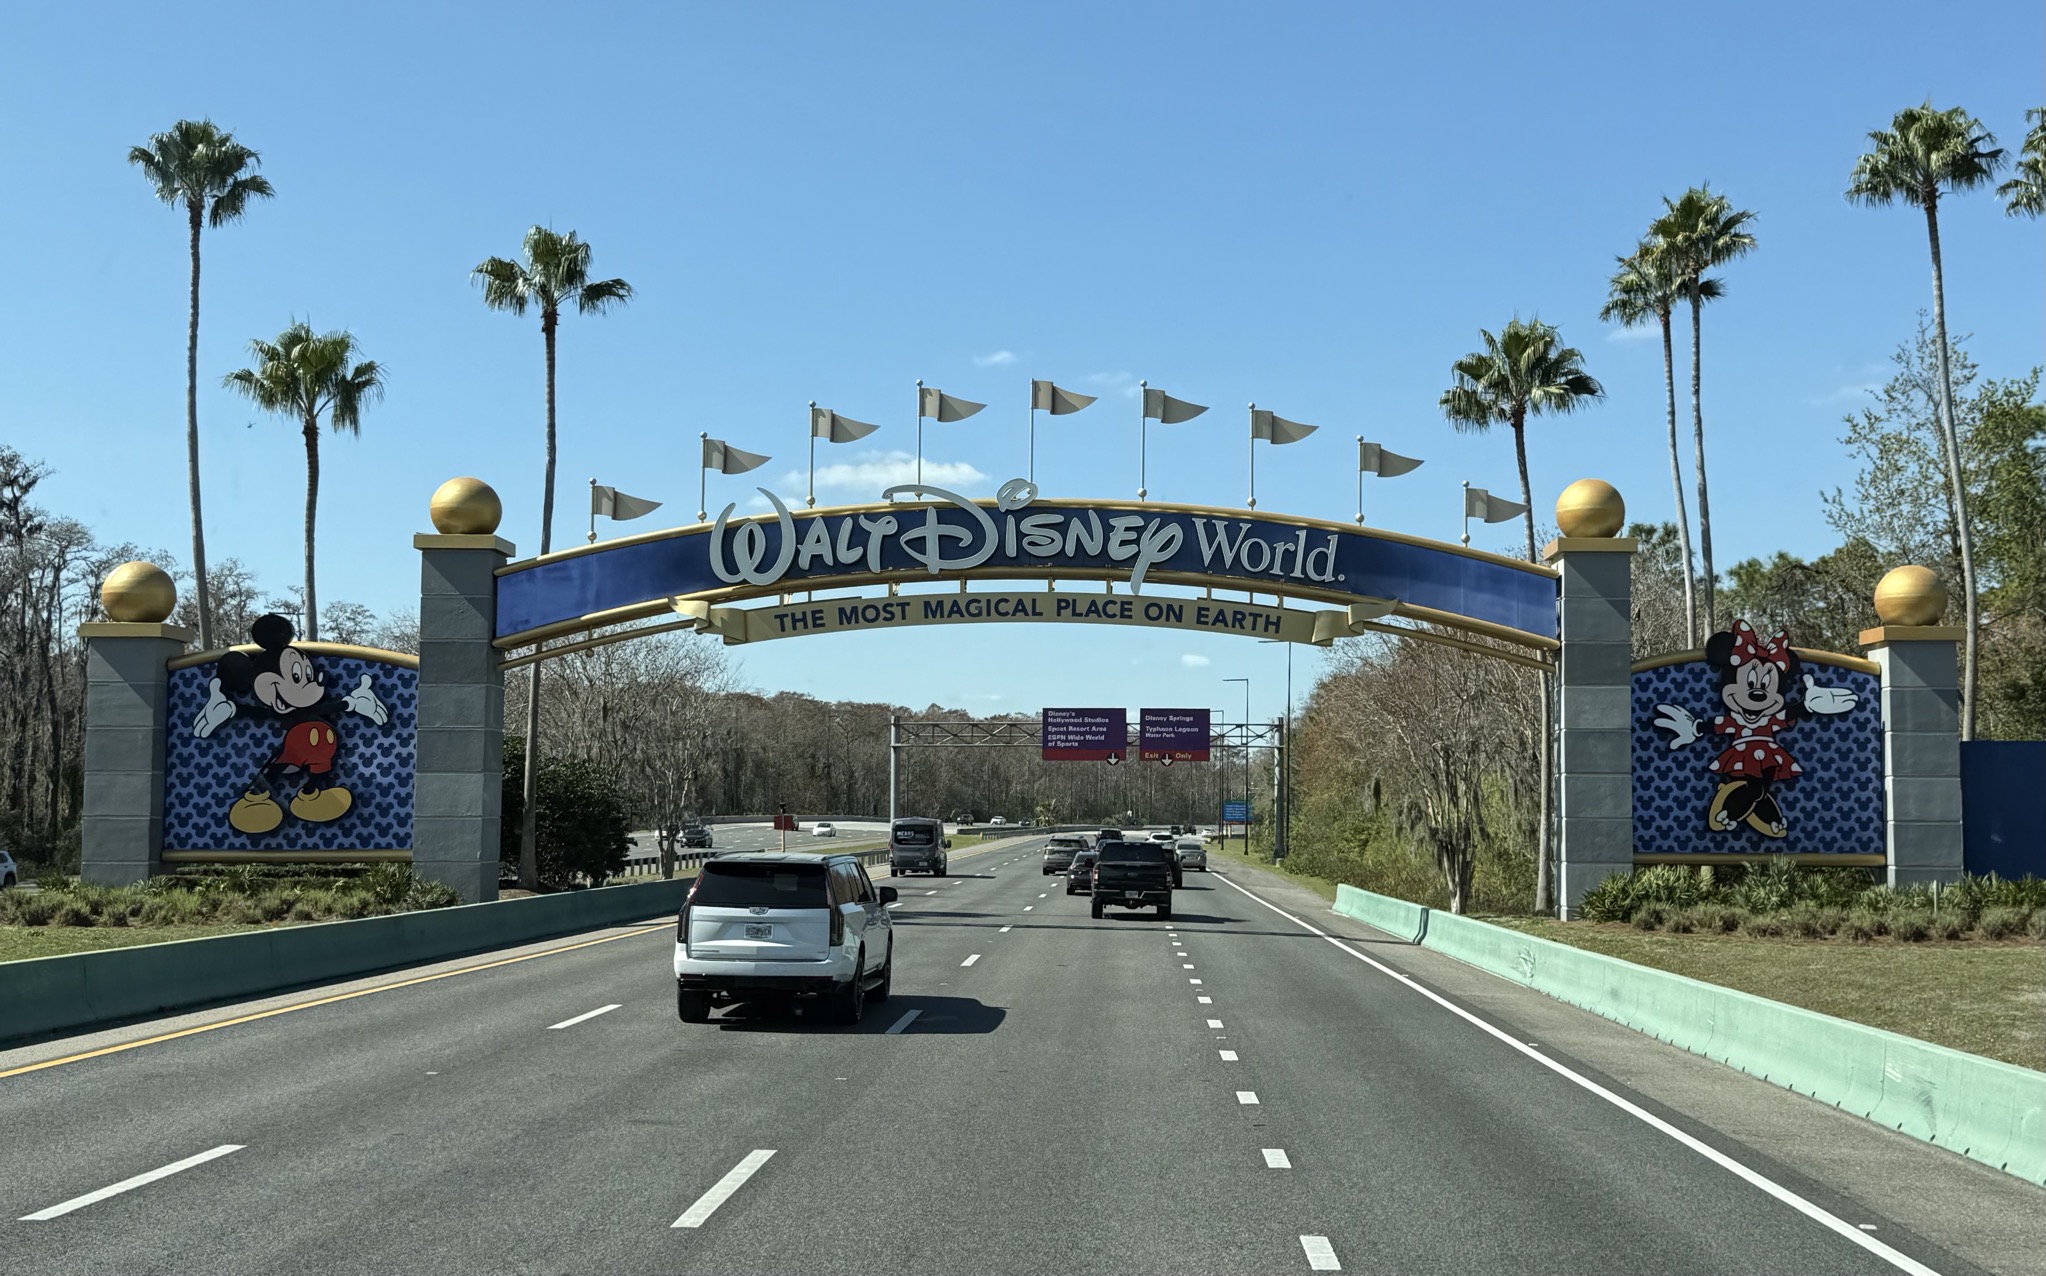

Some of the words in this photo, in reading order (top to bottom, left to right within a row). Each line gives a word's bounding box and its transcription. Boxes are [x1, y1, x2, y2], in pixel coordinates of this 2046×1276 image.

[709, 487, 898, 586] WALT
[774, 609, 826, 632] THE
[838, 602, 910, 626] MOST
[923, 598, 1043, 619] MAGICAL
[1056, 598, 1133, 620] PLACE
[1144, 602, 1183, 623] ON
[1196, 607, 1281, 634] EARTH
